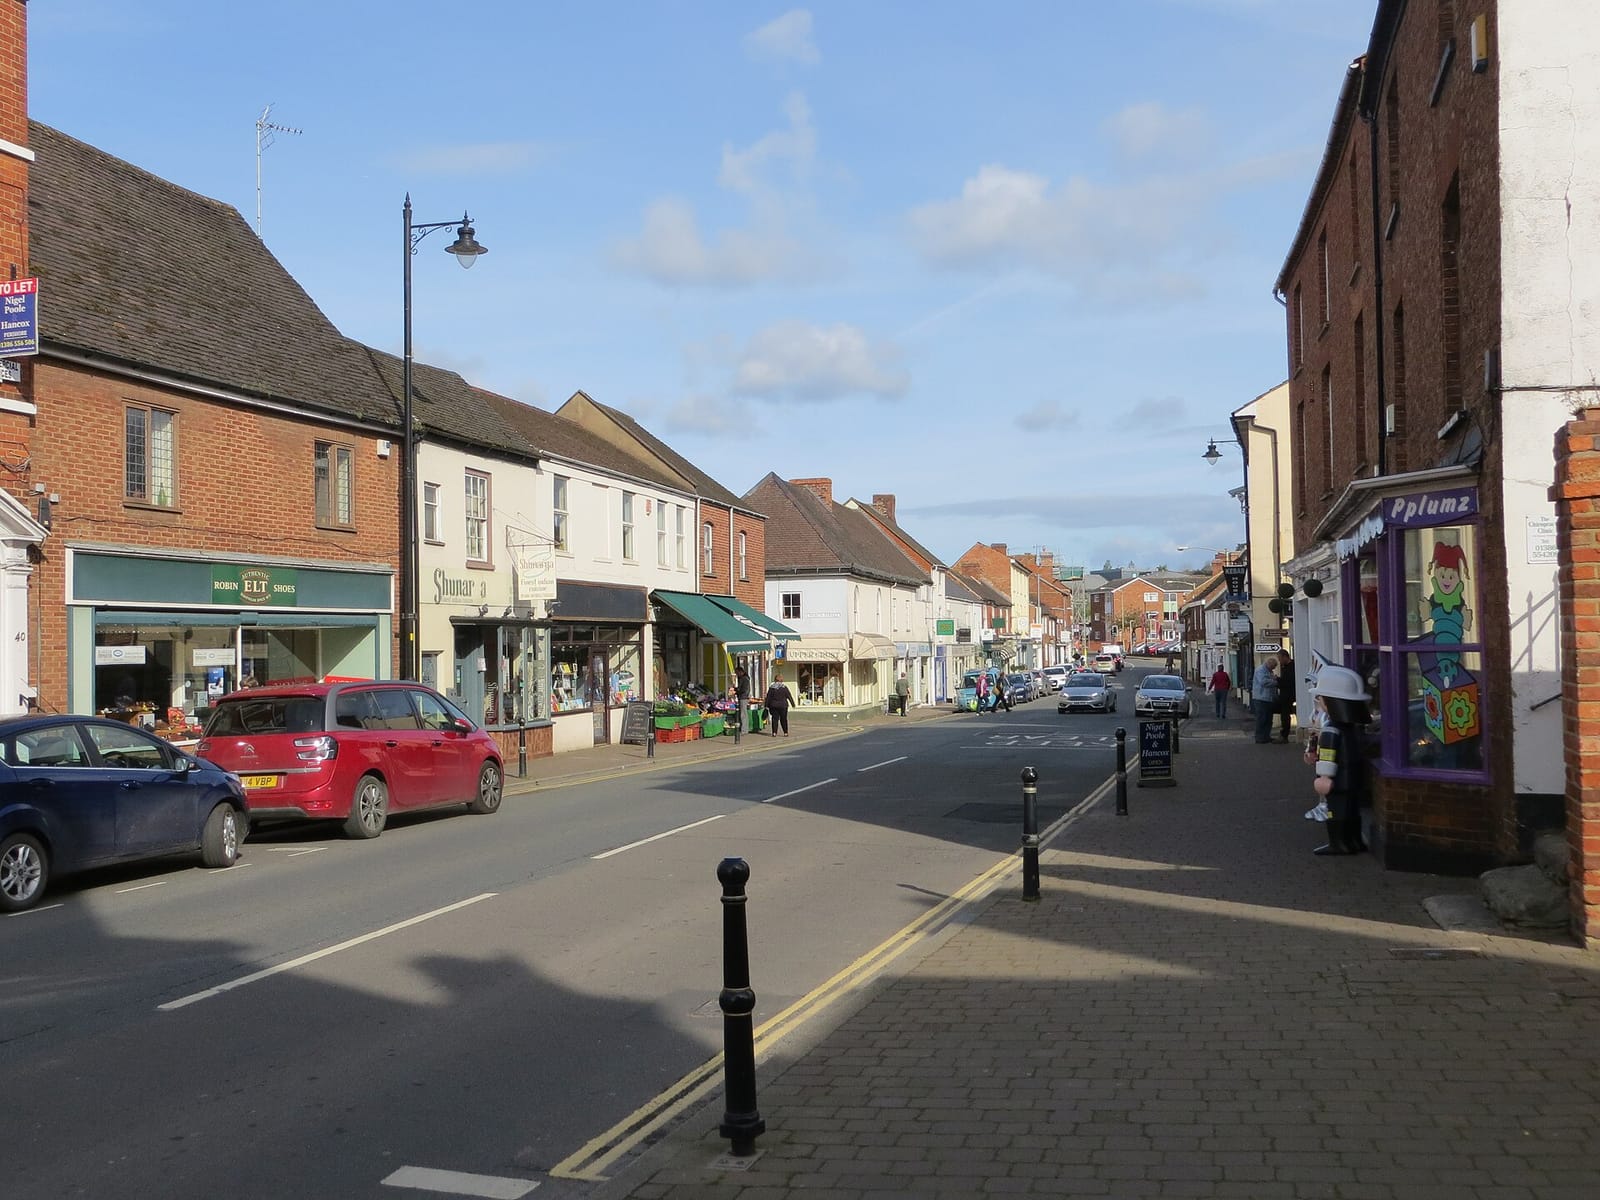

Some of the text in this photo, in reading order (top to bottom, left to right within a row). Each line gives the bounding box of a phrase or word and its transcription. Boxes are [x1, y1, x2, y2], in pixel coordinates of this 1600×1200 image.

[0, 281, 33, 295] TO LET
[5, 295, 26, 306] Nigel
[5, 304, 27, 314] Poole
[1, 320, 31, 330] Hancox
[241, 571, 270, 581] AUTHENTIC
[1224, 567, 1245, 575] KEBAB
[214, 580, 296, 594] ROBIN ELT SHOES
[14, 631, 26, 642] 40
[1145, 722, 1165, 732] Nigel
[1145, 731, 1165, 740] Poole
[255, 777, 272, 786] VBP
